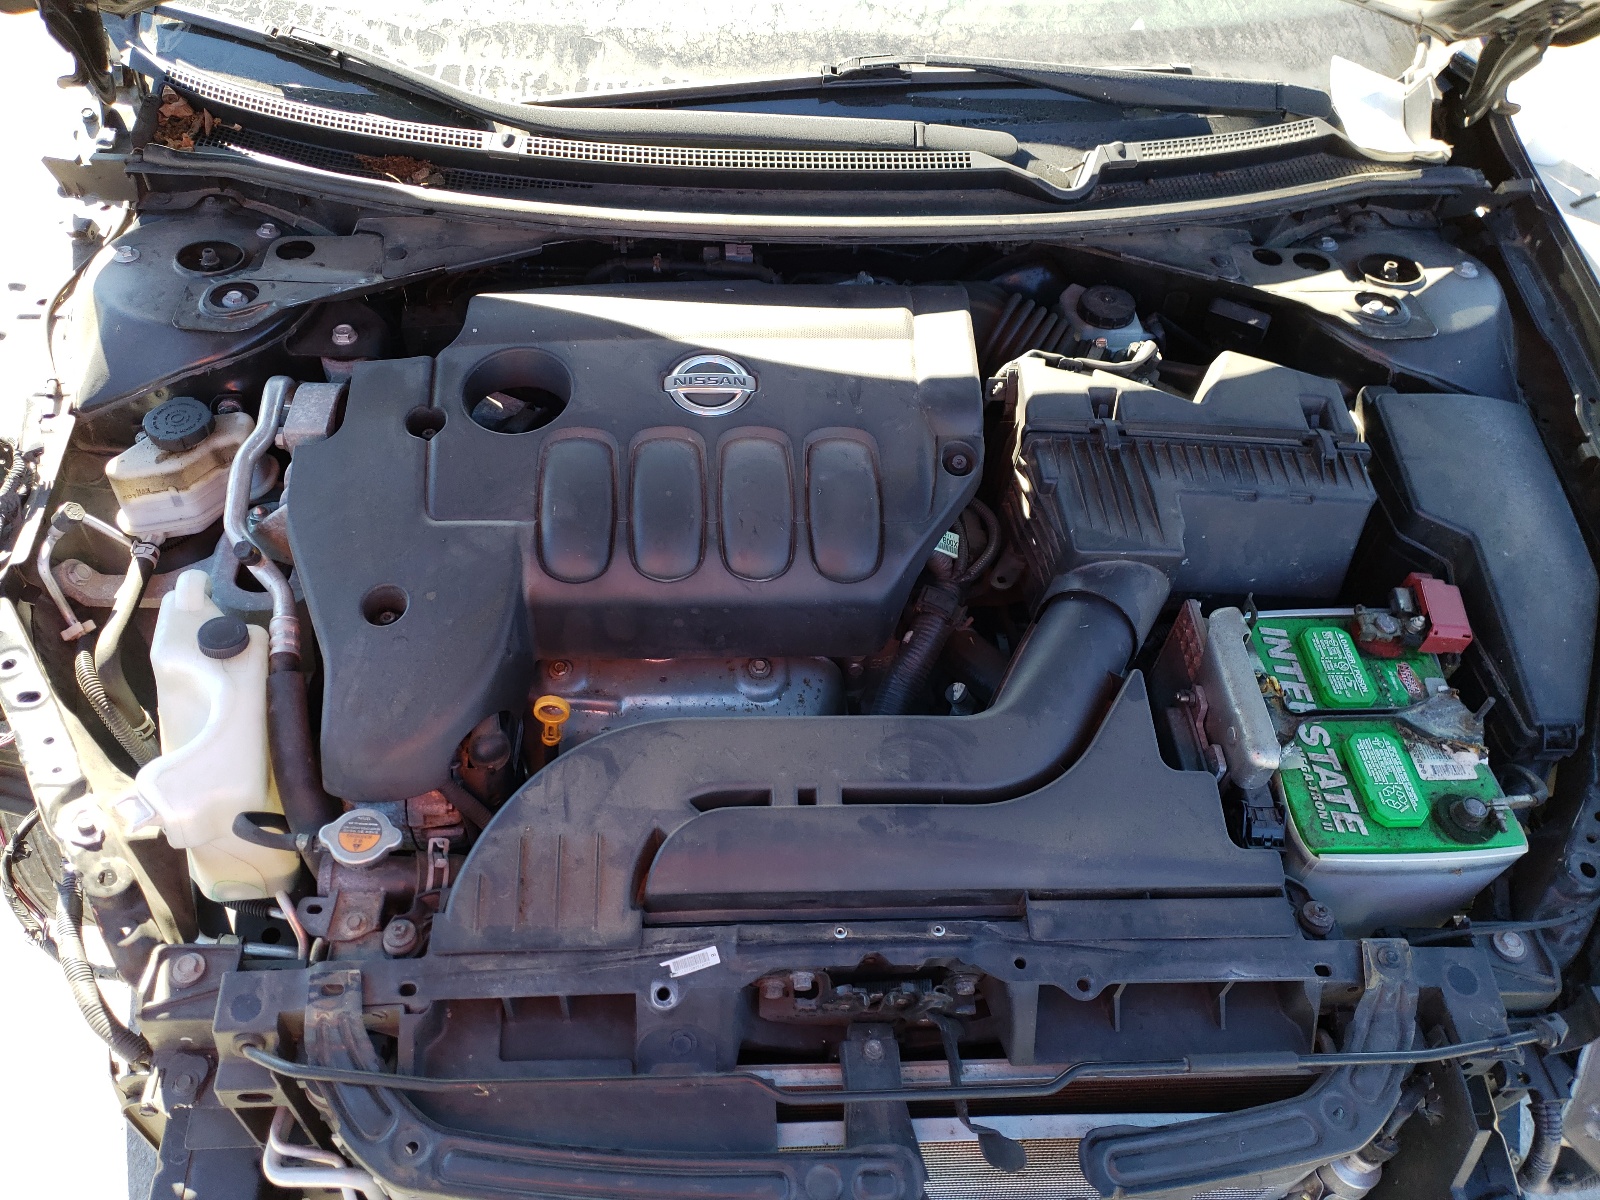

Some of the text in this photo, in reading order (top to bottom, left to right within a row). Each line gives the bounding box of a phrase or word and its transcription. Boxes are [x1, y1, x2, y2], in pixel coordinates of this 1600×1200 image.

[673, 376, 747, 386] NISSAN
[1340, 639, 1356, 665] DANGER
[1353, 668, 1369, 693] POISON
[1298, 724, 1369, 836] STATE
